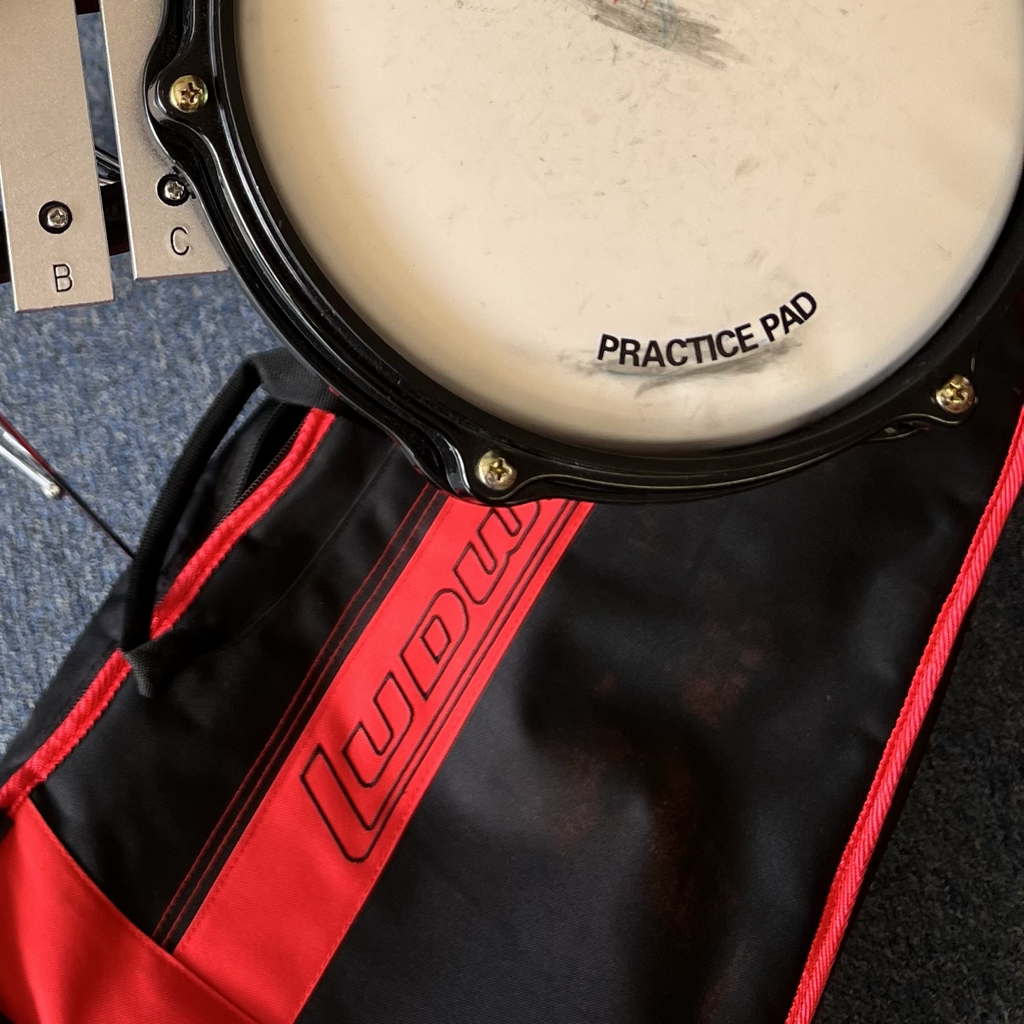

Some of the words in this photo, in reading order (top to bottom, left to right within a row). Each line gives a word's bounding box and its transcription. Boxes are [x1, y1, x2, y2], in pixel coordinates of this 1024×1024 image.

[170, 227, 189, 255] C
[53, 264, 73, 292] B
[597, 322, 759, 367] PRACTICE
[760, 291, 817, 343] PAD
[300, 498, 574, 862] Ludw
